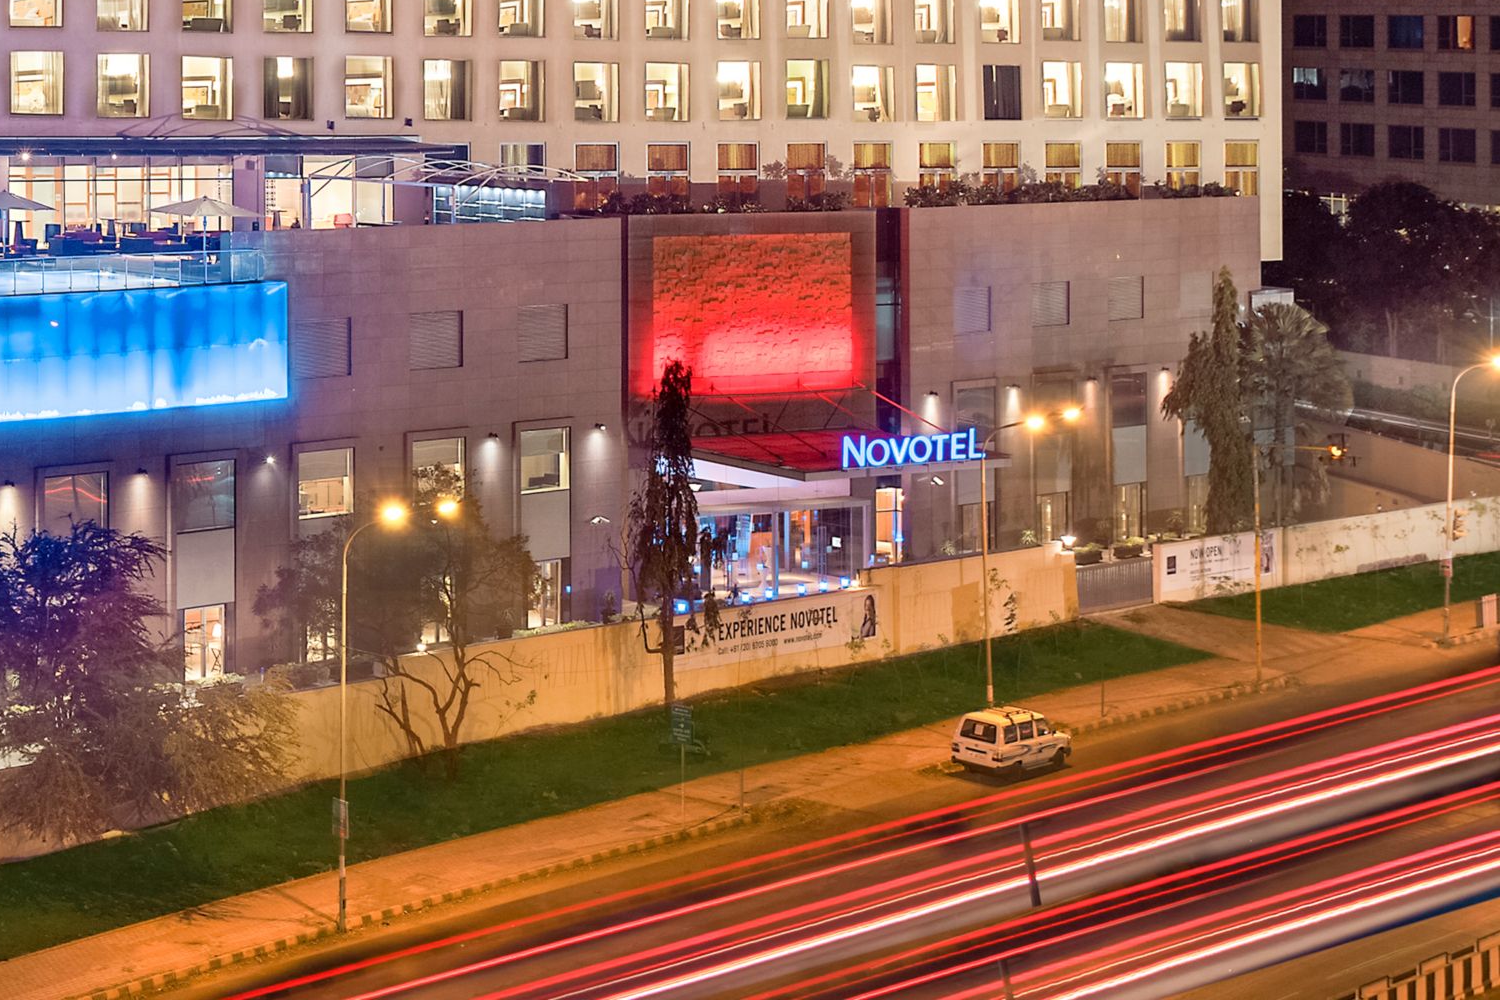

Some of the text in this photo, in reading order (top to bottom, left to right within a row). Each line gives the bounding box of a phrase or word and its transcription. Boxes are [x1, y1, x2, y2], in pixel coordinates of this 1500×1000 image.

[842, 428, 985, 468] NOVOTEL
[1206, 545, 1222, 558] OPEN
[718, 606, 838, 641] EXPERIENCE NOVOTEL
